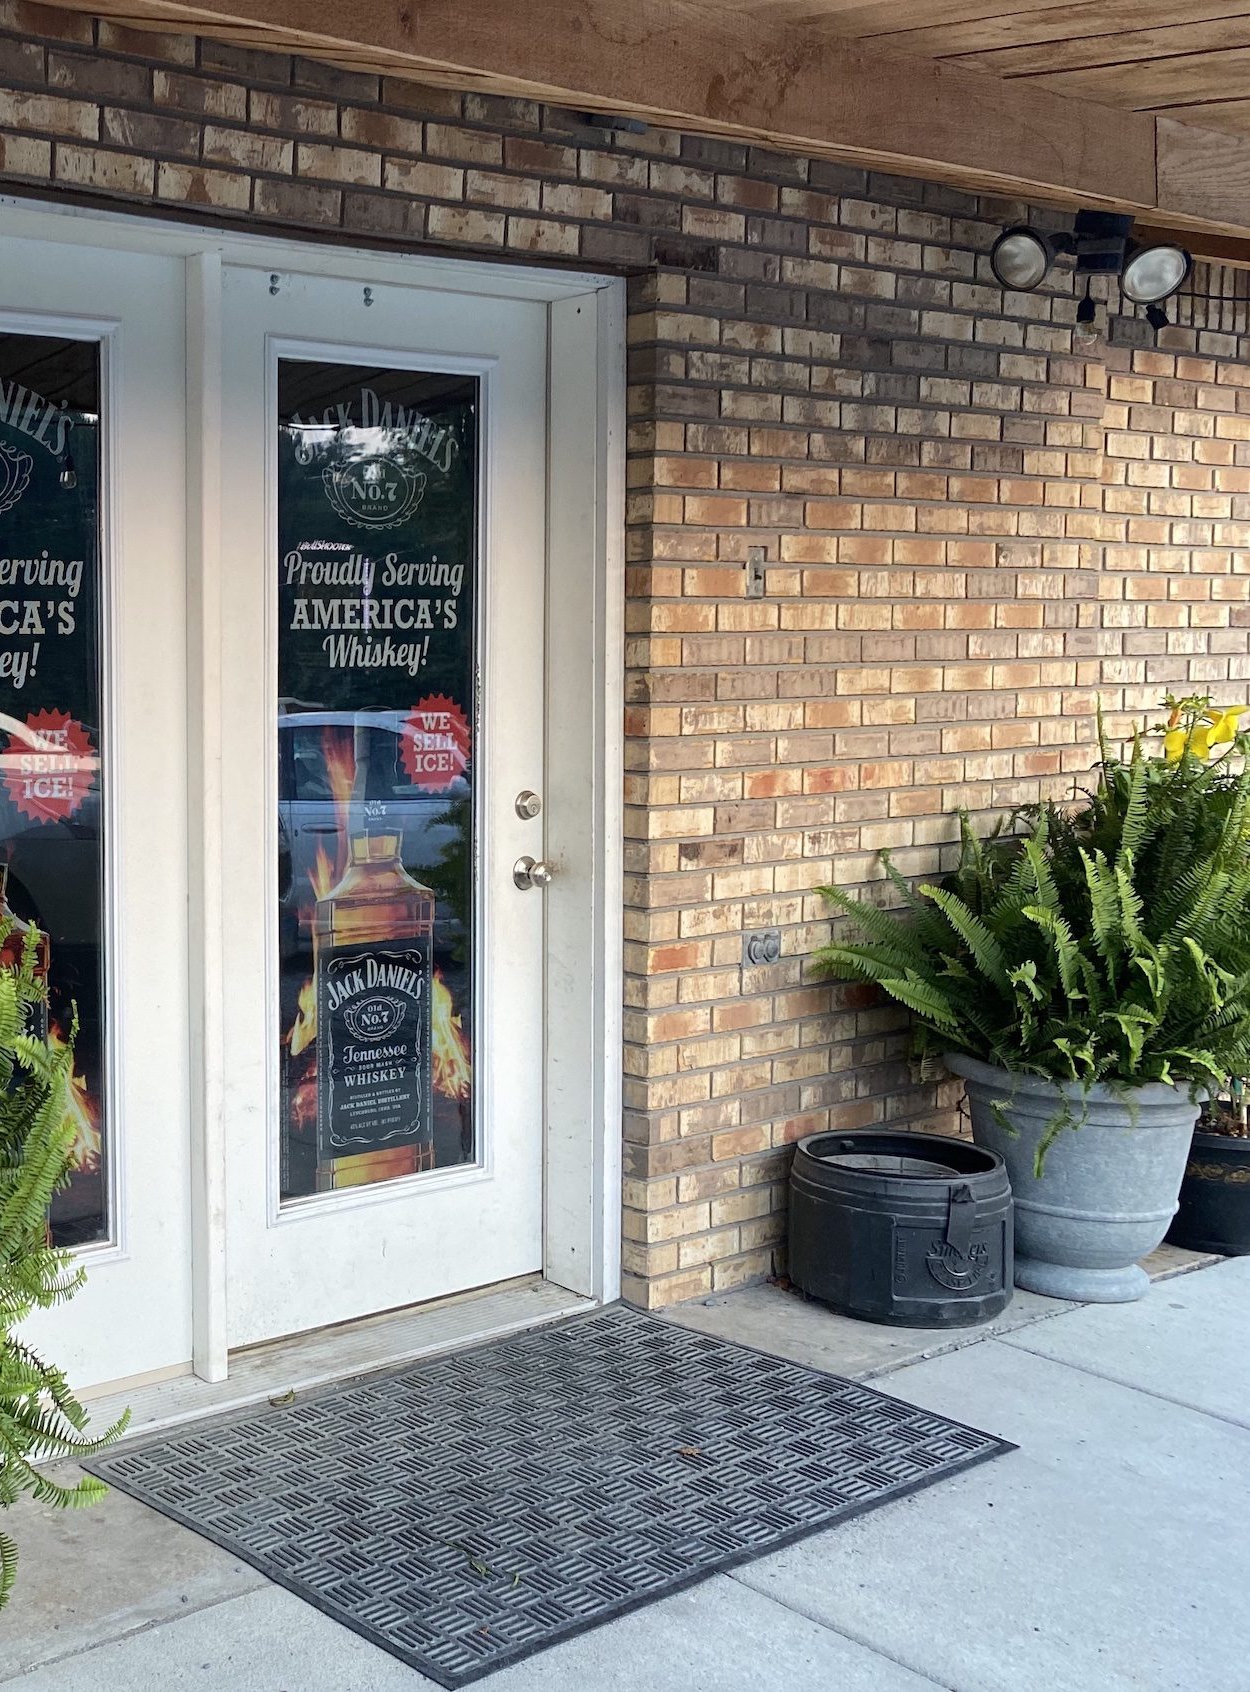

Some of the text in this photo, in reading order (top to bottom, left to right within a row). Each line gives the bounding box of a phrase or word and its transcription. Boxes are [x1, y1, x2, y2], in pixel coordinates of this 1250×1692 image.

[362, 503, 389, 512] BRAND
[284, 551, 464, 597] Proudly Serving
[290, 598, 457, 630] AMERICA'S
[323, 634, 429, 677] Whiskey!
[420, 713, 450, 730] WE
[34, 730, 68, 751] WE
[413, 733, 458, 751] SELL
[20, 755, 78, 774] SELL
[415, 753, 454, 773] ICE!
[23, 777, 73, 800] ICE!
[326, 958, 425, 1011] JACK DANIEL'S
[367, 1004, 382, 1012] Old
[343, 1044, 407, 1064] Tennessee
[344, 1066, 406, 1087] WHISKEY
